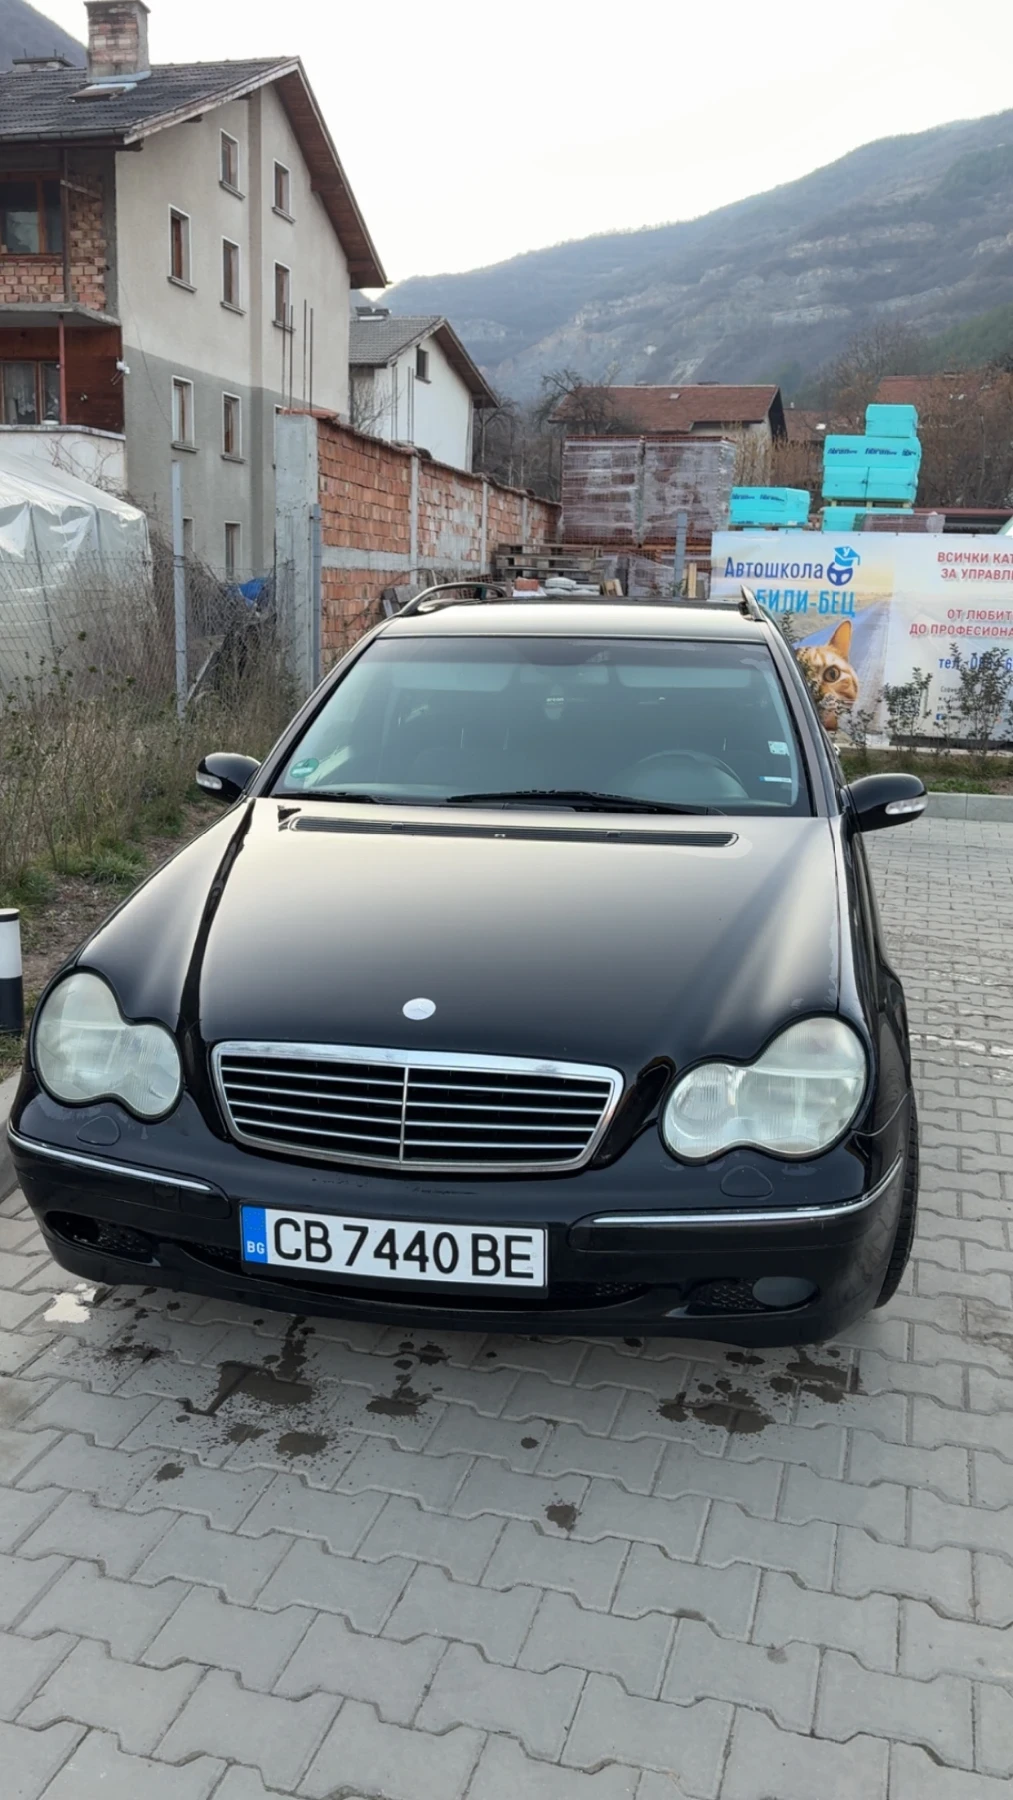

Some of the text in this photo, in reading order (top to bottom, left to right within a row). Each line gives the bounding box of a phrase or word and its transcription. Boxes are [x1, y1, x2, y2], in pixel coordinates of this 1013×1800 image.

[937, 551, 989, 563] ВСИЧКИ
[724, 556, 824, 579] Автошкола
[941, 568, 1013, 581] ЗА УПРАВЛ
[947, 608, 963, 620] ОТ
[909, 623, 927, 635] ДО
[247, 1240, 265, 1254] BG
[273, 1217, 534, 1279] CB 7440 BE
